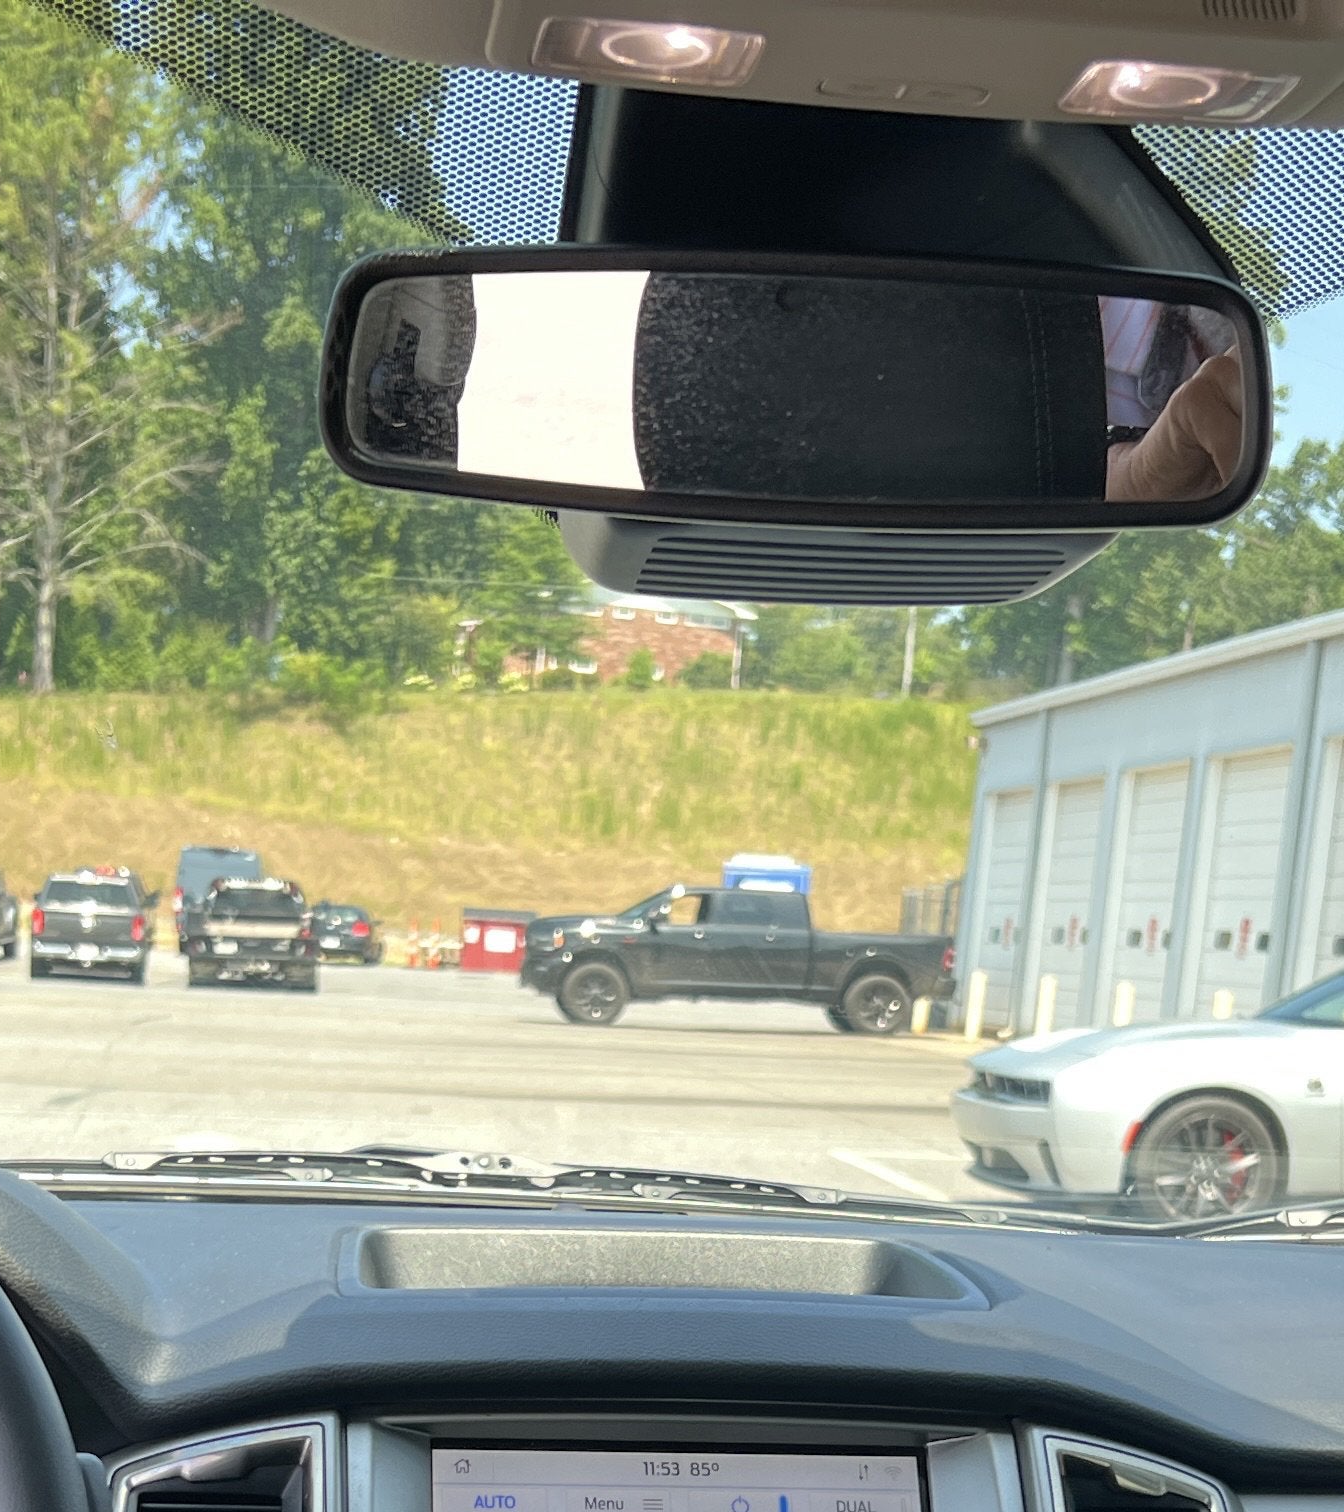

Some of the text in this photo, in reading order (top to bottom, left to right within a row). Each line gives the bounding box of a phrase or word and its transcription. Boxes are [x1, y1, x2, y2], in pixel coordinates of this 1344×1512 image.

[642, 1461, 720, 1478] 11:53 85°
[473, 1494, 517, 1510] AUTO
[583, 1496, 625, 1511] Menu
